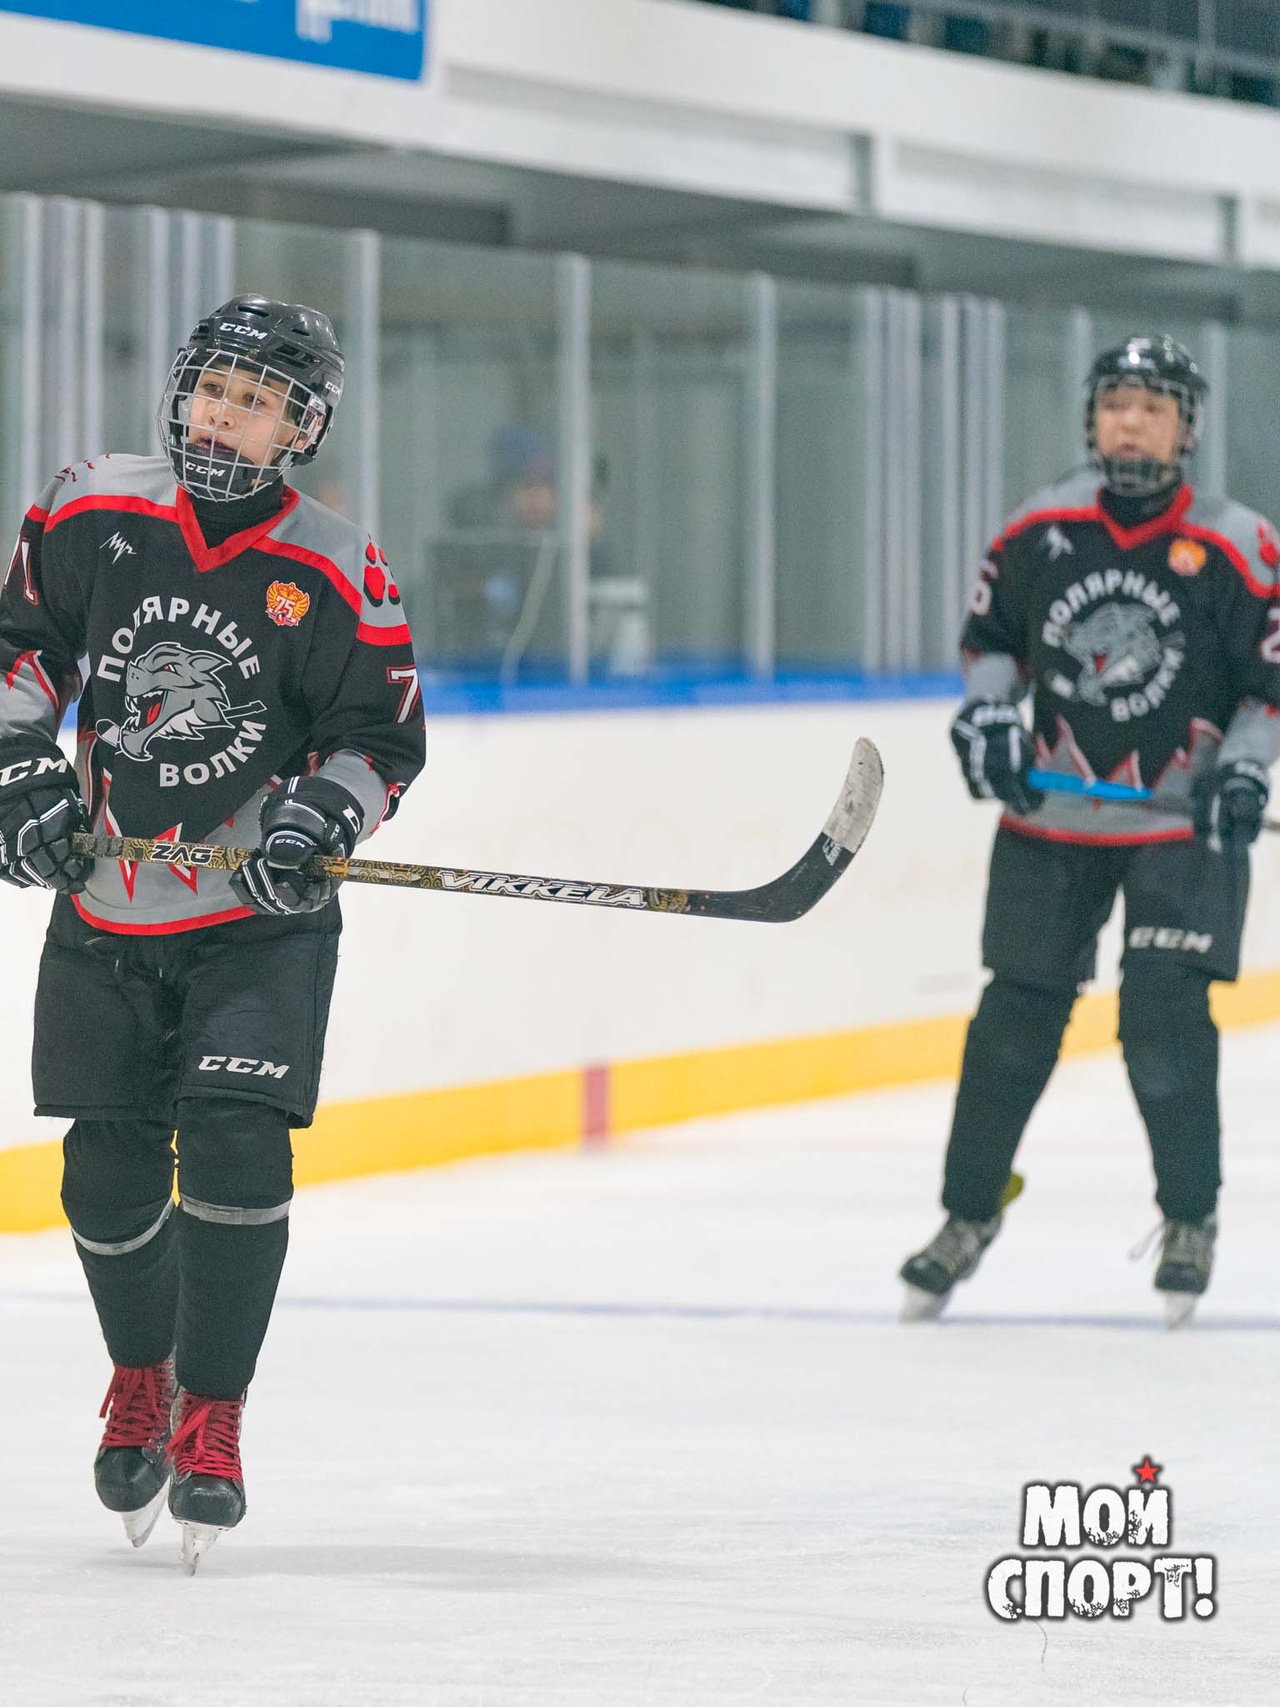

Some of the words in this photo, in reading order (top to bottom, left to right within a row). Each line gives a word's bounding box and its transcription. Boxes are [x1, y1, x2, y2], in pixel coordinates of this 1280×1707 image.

[219, 322, 268, 340] CCM
[185, 461, 226, 477] CCM
[274, 595, 296, 618] 75
[96, 595, 261, 683] ПОЛЯРНЫЕ
[159, 720, 266, 787] ВОЛКИ
[150, 843, 228, 865] ZAG
[437, 869, 647, 908] VIKKELA
[198, 1055, 290, 1079] CCM
